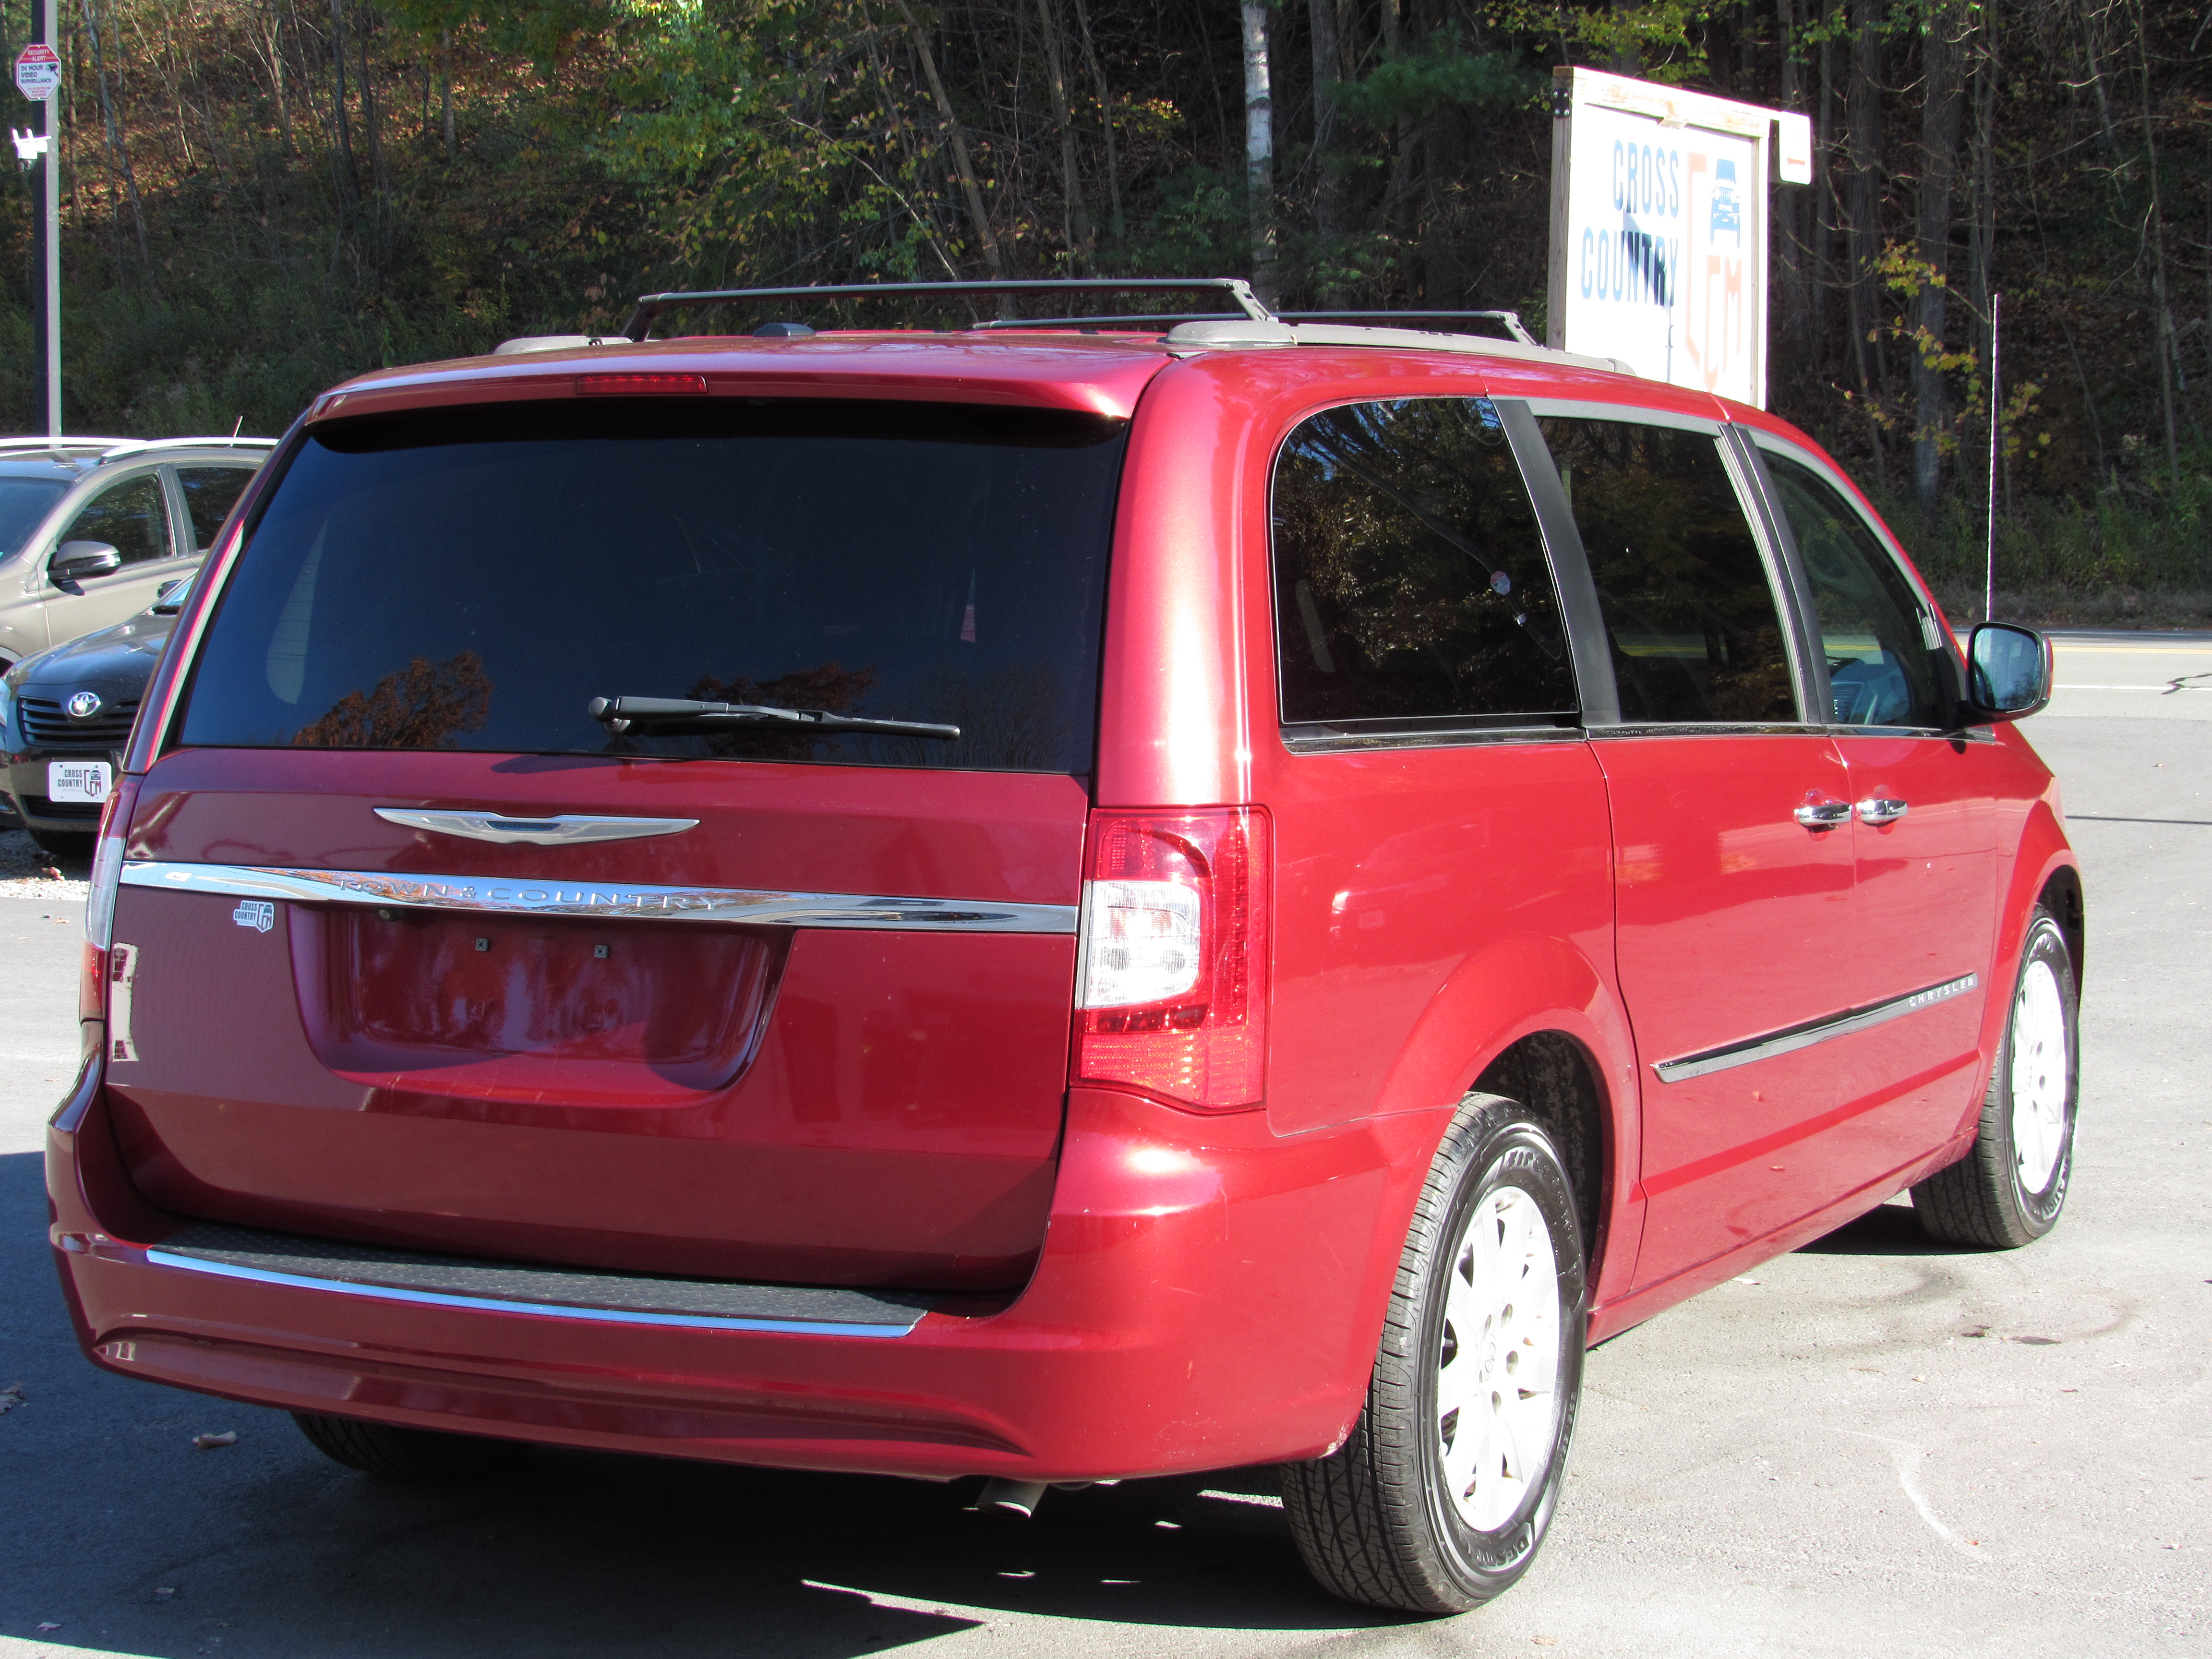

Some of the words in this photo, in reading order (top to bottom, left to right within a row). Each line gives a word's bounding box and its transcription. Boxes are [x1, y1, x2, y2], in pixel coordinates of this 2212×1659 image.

[1613, 139, 1678, 218] CROSS
[1581, 227, 1678, 307] COUNTRY
[58, 779, 83, 787] COUNTRY
[64, 769, 82, 778] CROSS
[335, 879, 448, 897] TOWN
[487, 888, 722, 910] COUNTRY
[235, 911, 256, 920] COUNTRY
[241, 902, 257, 911] CROSS
[1909, 977, 1973, 1007] CHRYSLER
